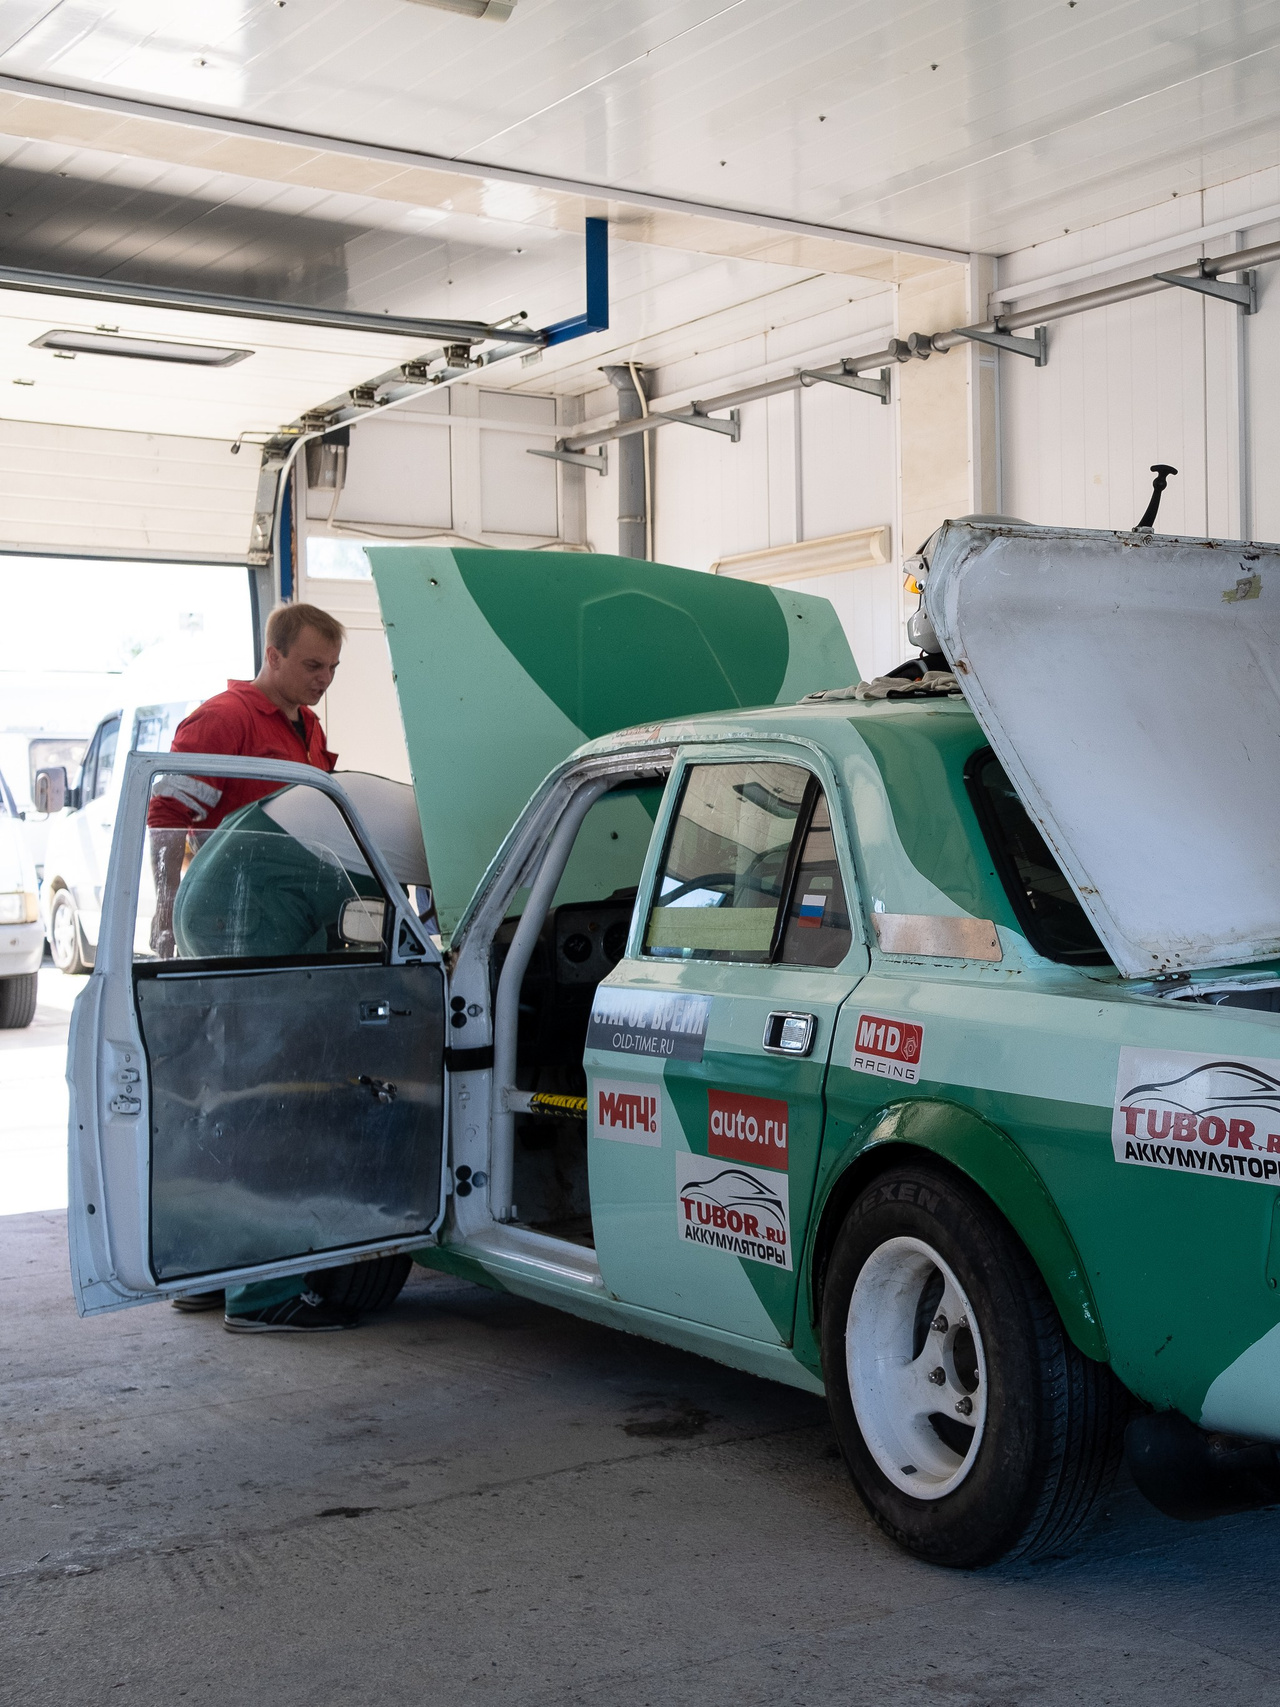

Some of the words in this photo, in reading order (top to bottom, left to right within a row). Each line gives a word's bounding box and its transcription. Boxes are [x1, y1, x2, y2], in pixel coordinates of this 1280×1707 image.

[612, 1032, 675, 1055] OLD-TIME.RU
[858, 1021, 900, 1053] M1D
[853, 1057, 916, 1080] RACING
[599, 1091, 657, 1133] МАТЧ!
[710, 1109, 787, 1149] auto.ru
[680, 1197, 787, 1246] TUBOR.RU
[684, 1223, 787, 1267] АККУМУЛЯТОРЫ
